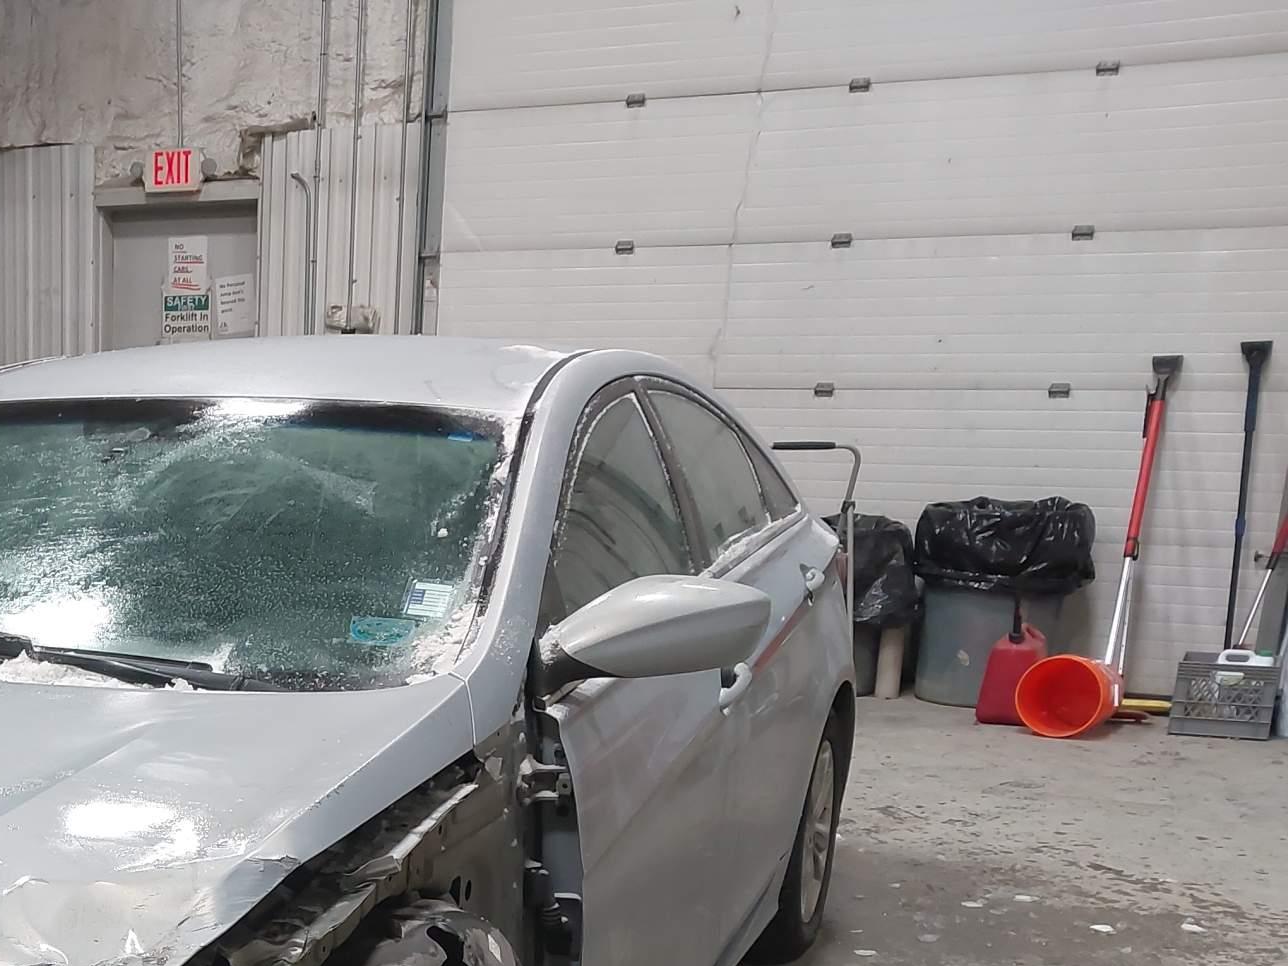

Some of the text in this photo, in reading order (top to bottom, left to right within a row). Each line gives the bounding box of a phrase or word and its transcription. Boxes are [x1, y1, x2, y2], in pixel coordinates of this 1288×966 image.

[153, 150, 192, 185] EXIT
[166, 295, 207, 306] SAFETY
[165, 312, 209, 321] Forklift In
[164, 324, 209, 334] Operation
